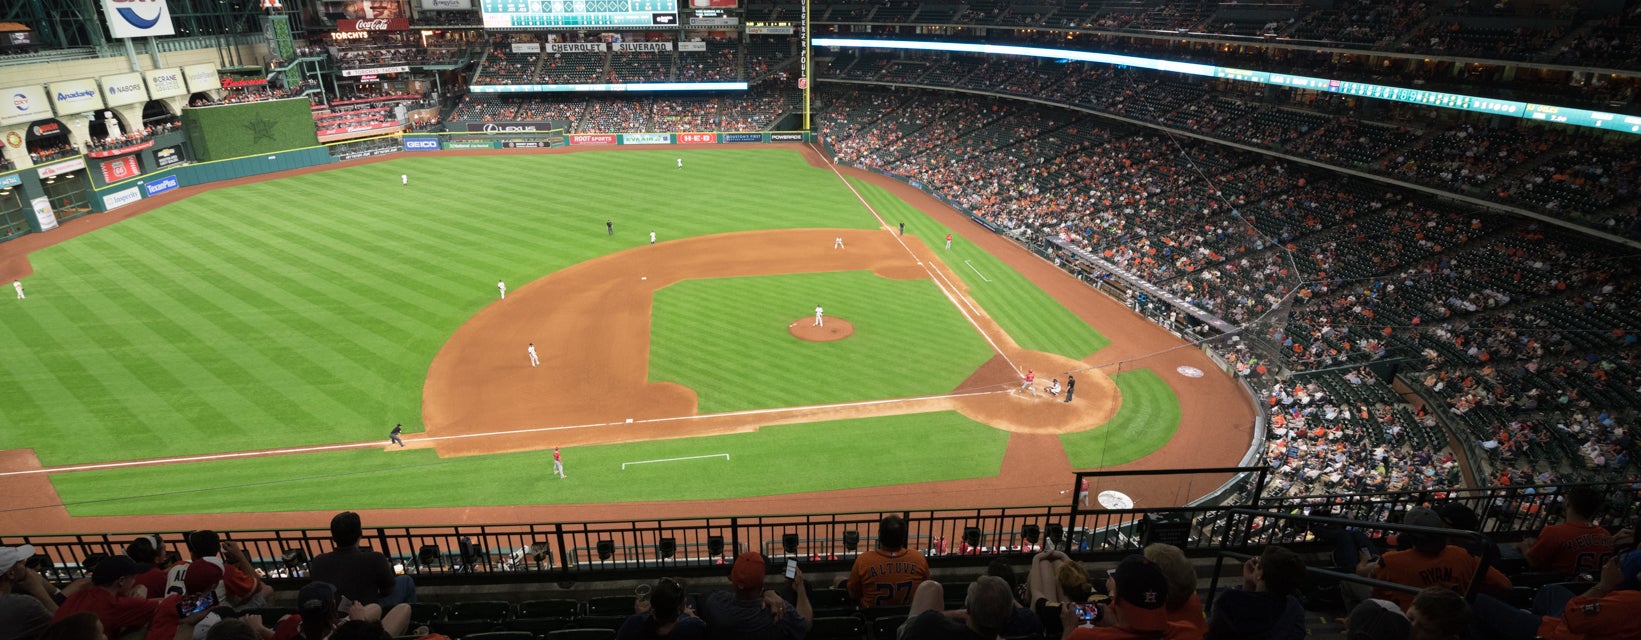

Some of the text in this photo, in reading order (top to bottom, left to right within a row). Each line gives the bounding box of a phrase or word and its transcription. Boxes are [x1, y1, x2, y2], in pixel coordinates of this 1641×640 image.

[355, 19, 389, 31] Coca-Cola
[331, 31, 369, 40] TORCHYS
[551, 43, 600, 51] CHEVROLET
[619, 43, 667, 51] SILVERADO
[157, 74, 177, 82] CRANE
[117, 84, 141, 93] NABORS
[57, 89, 95, 102] Anadarko
[147, 179, 177, 193] TexanPlus
[869, 561, 917, 578] ALTUVE
[1418, 567, 1453, 586] RYAN
[875, 580, 913, 607] 27
